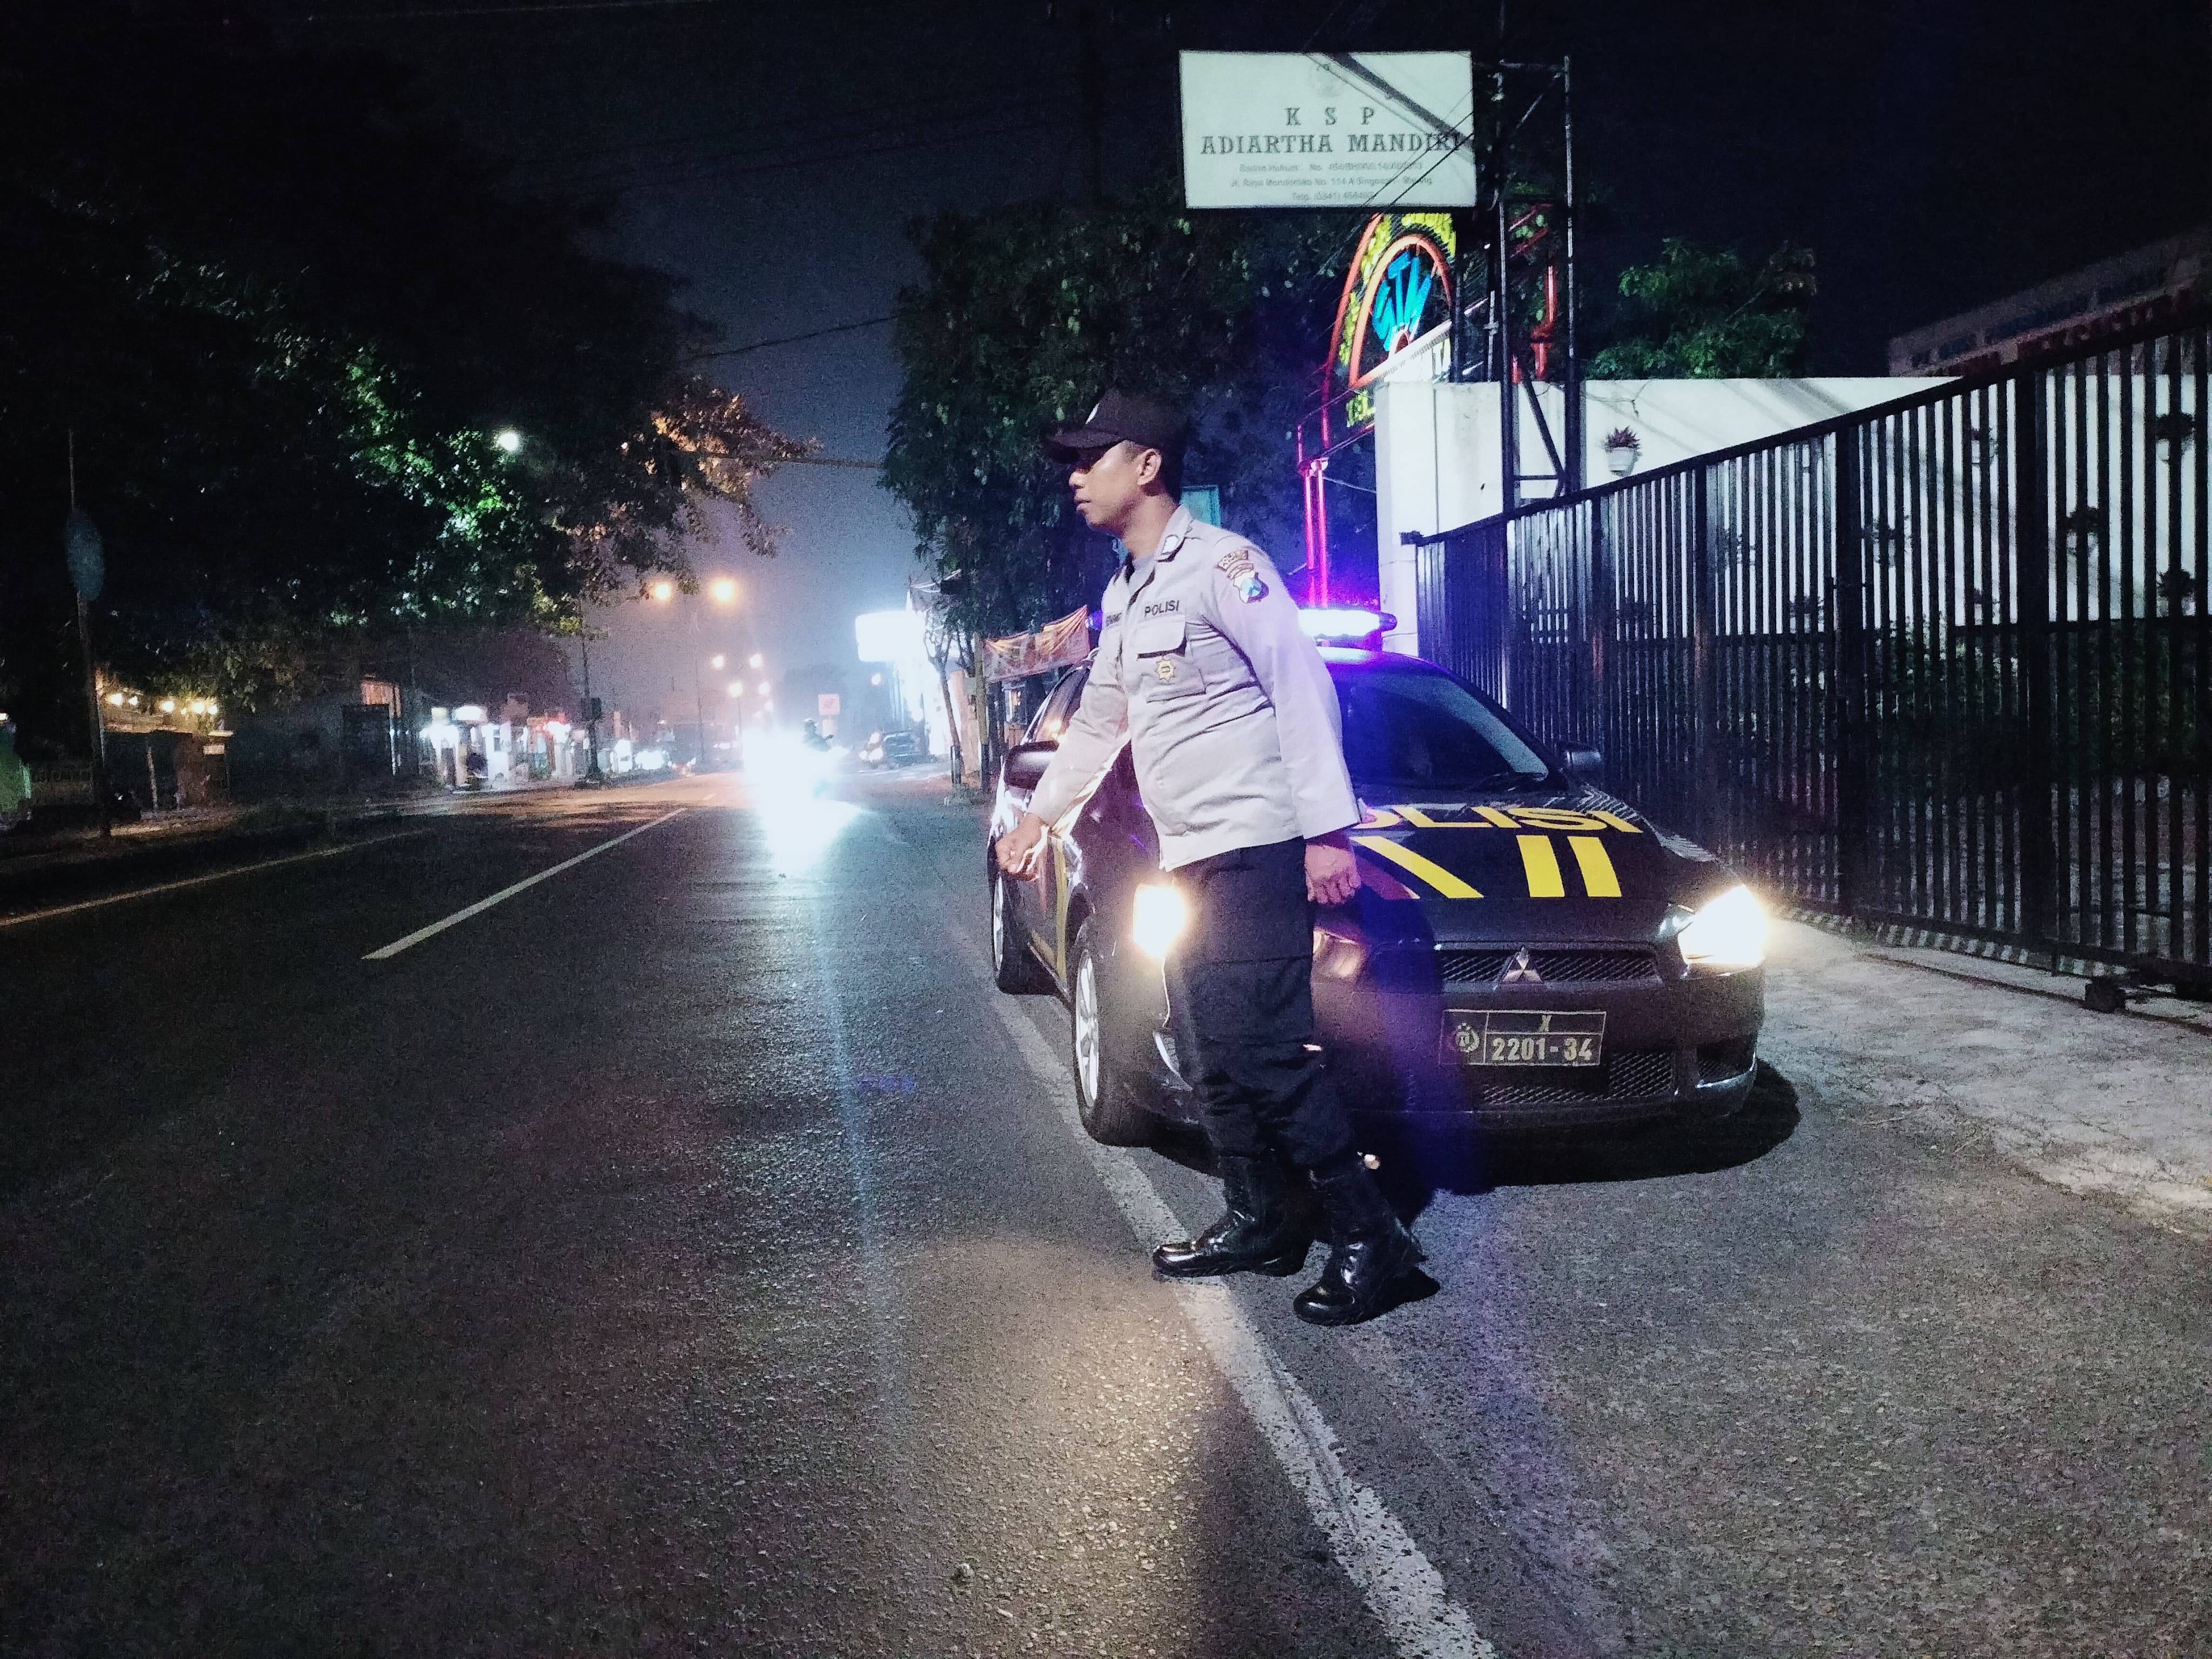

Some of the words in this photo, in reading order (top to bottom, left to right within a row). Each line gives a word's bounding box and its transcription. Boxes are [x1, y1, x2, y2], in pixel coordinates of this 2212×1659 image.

[1284, 107, 1301, 126] K
[1325, 107, 1337, 126] S
[1359, 106, 1375, 125] P
[1201, 134, 1333, 155] ADIARTHA
[1144, 600, 1179, 618] POLISI
